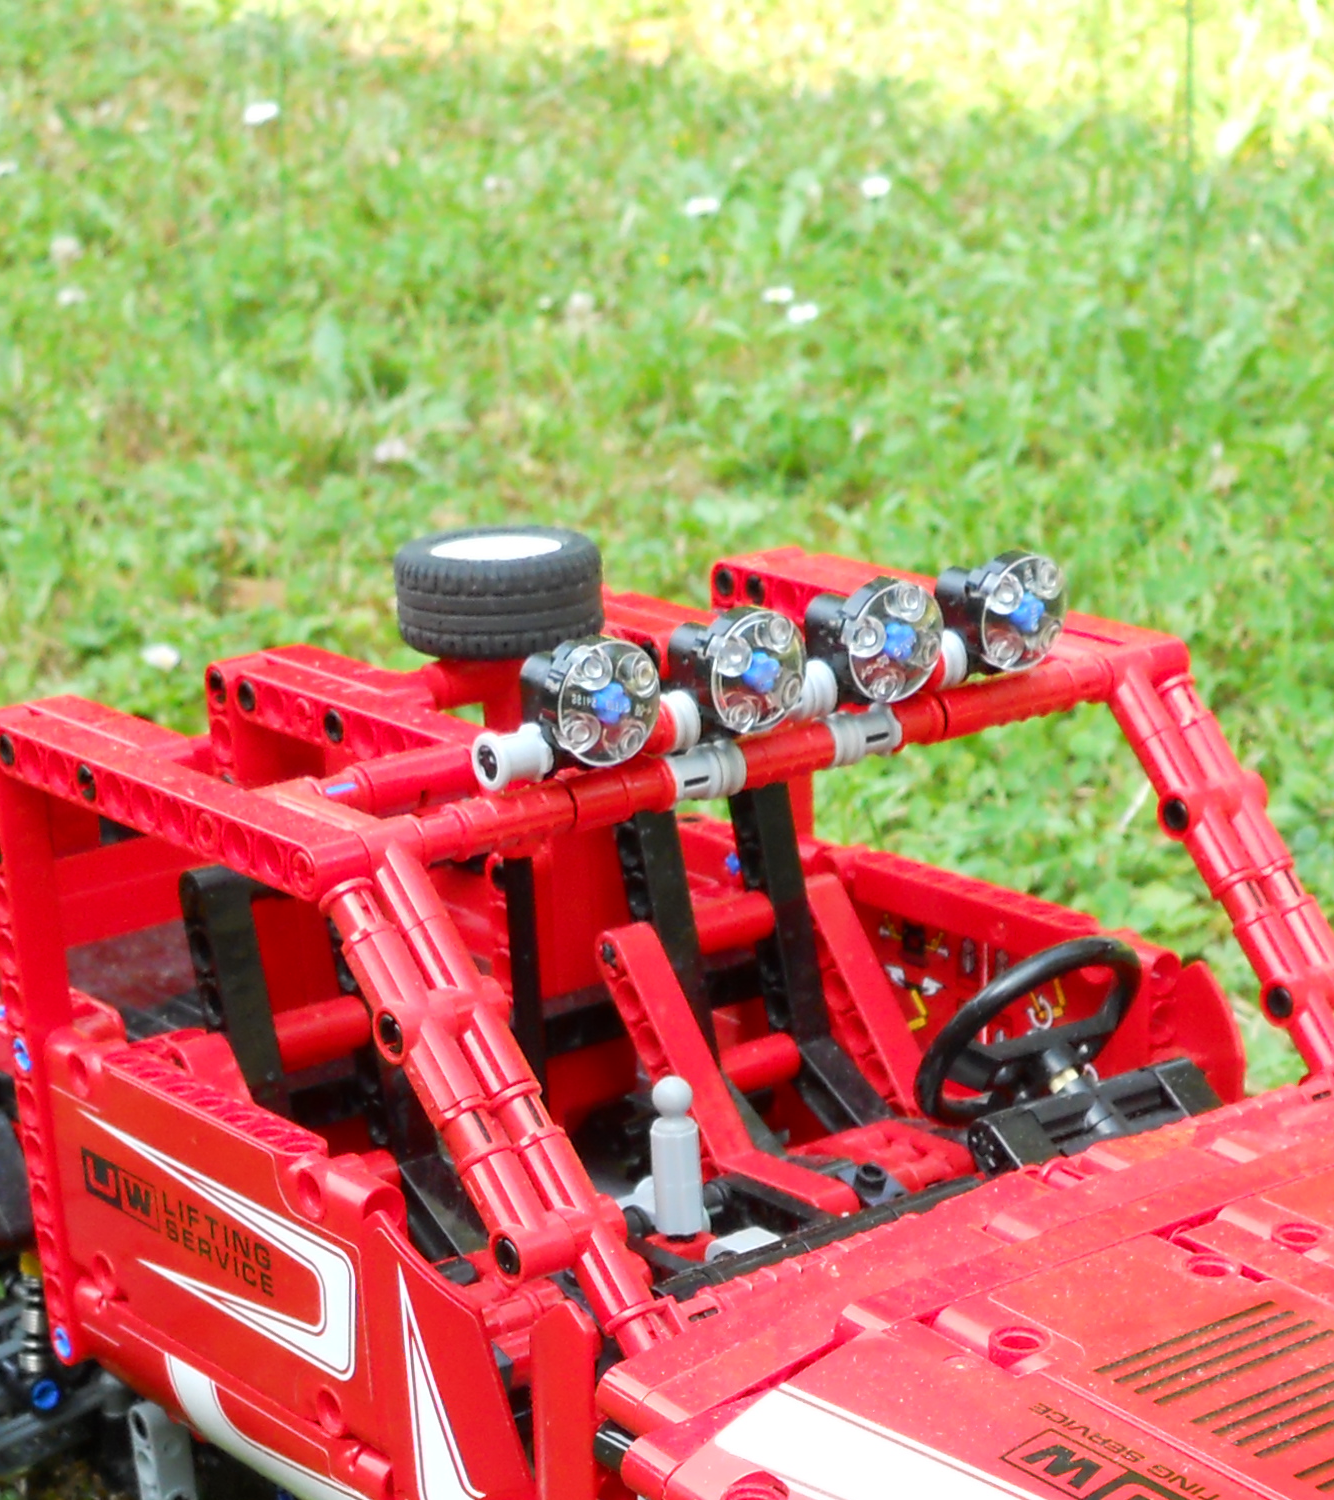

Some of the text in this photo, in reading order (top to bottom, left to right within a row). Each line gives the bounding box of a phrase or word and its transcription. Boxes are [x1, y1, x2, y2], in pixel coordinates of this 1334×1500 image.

[162, 1191, 272, 1272] LIFTING
[165, 1219, 275, 1298] SERVICE
[1028, 1402, 1148, 1464] SERVICE
